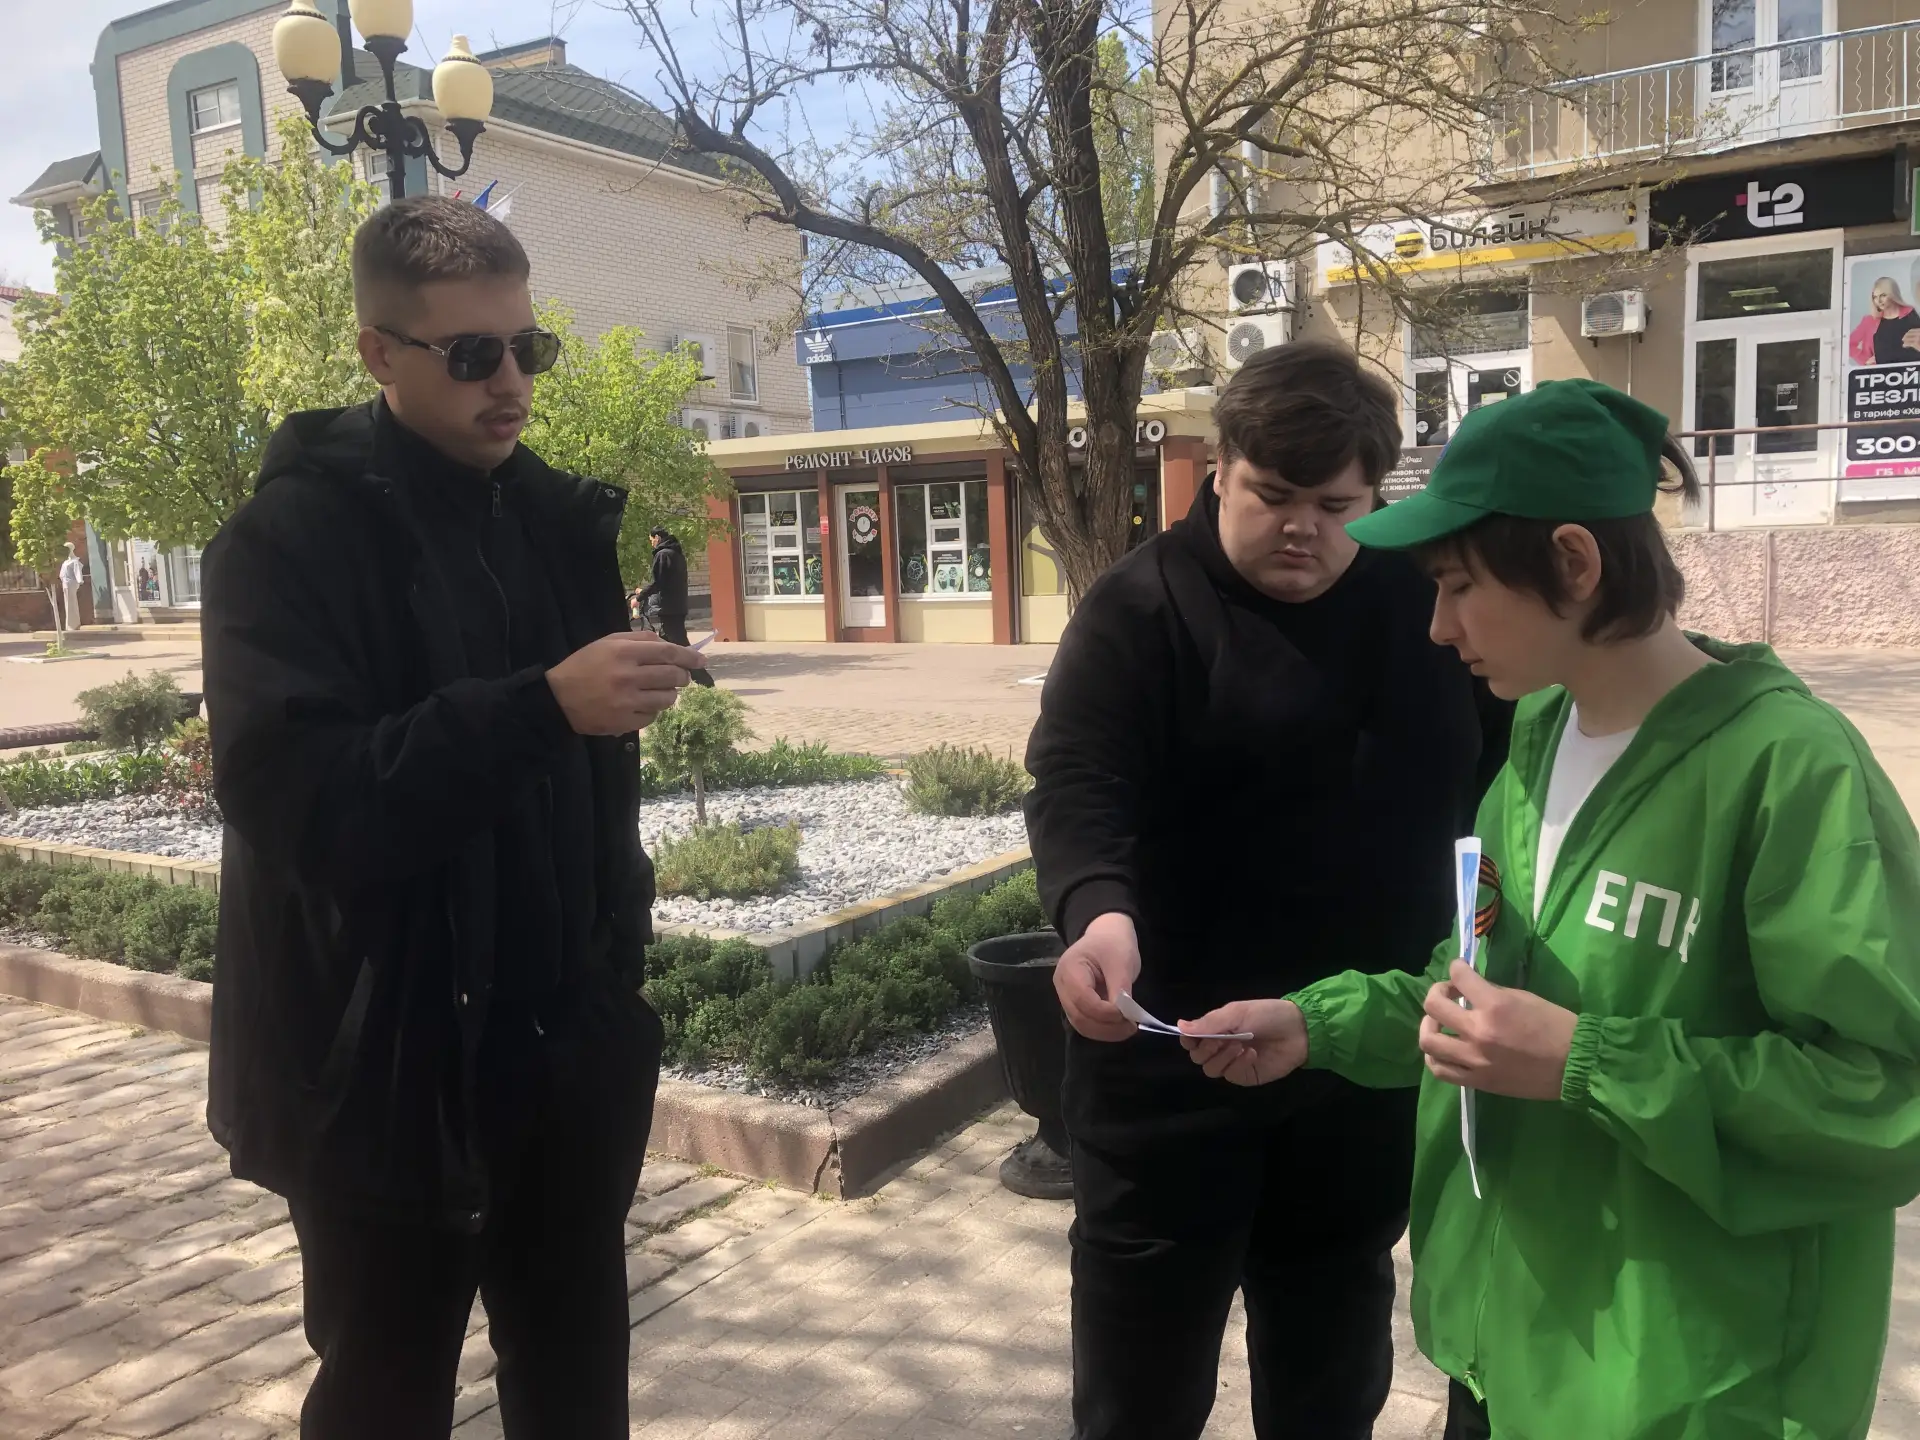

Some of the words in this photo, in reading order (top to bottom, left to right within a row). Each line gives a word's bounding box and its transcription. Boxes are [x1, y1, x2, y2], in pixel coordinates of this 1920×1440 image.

[1736, 181, 1804, 228] t2
[1430, 212, 1546, 251] билайн
[806, 353, 832, 363] adidas
[1855, 367, 1920, 388] ТРОЙ
[1855, 388, 1920, 406] БЕЗЛ
[1854, 410, 1860, 418] В
[1863, 408, 1900, 419] тарифе
[1902, 407, 1920, 415] «Хв
[785, 451, 853, 470] РЕМОНТ
[860, 445, 912, 465] ЧАСОВ
